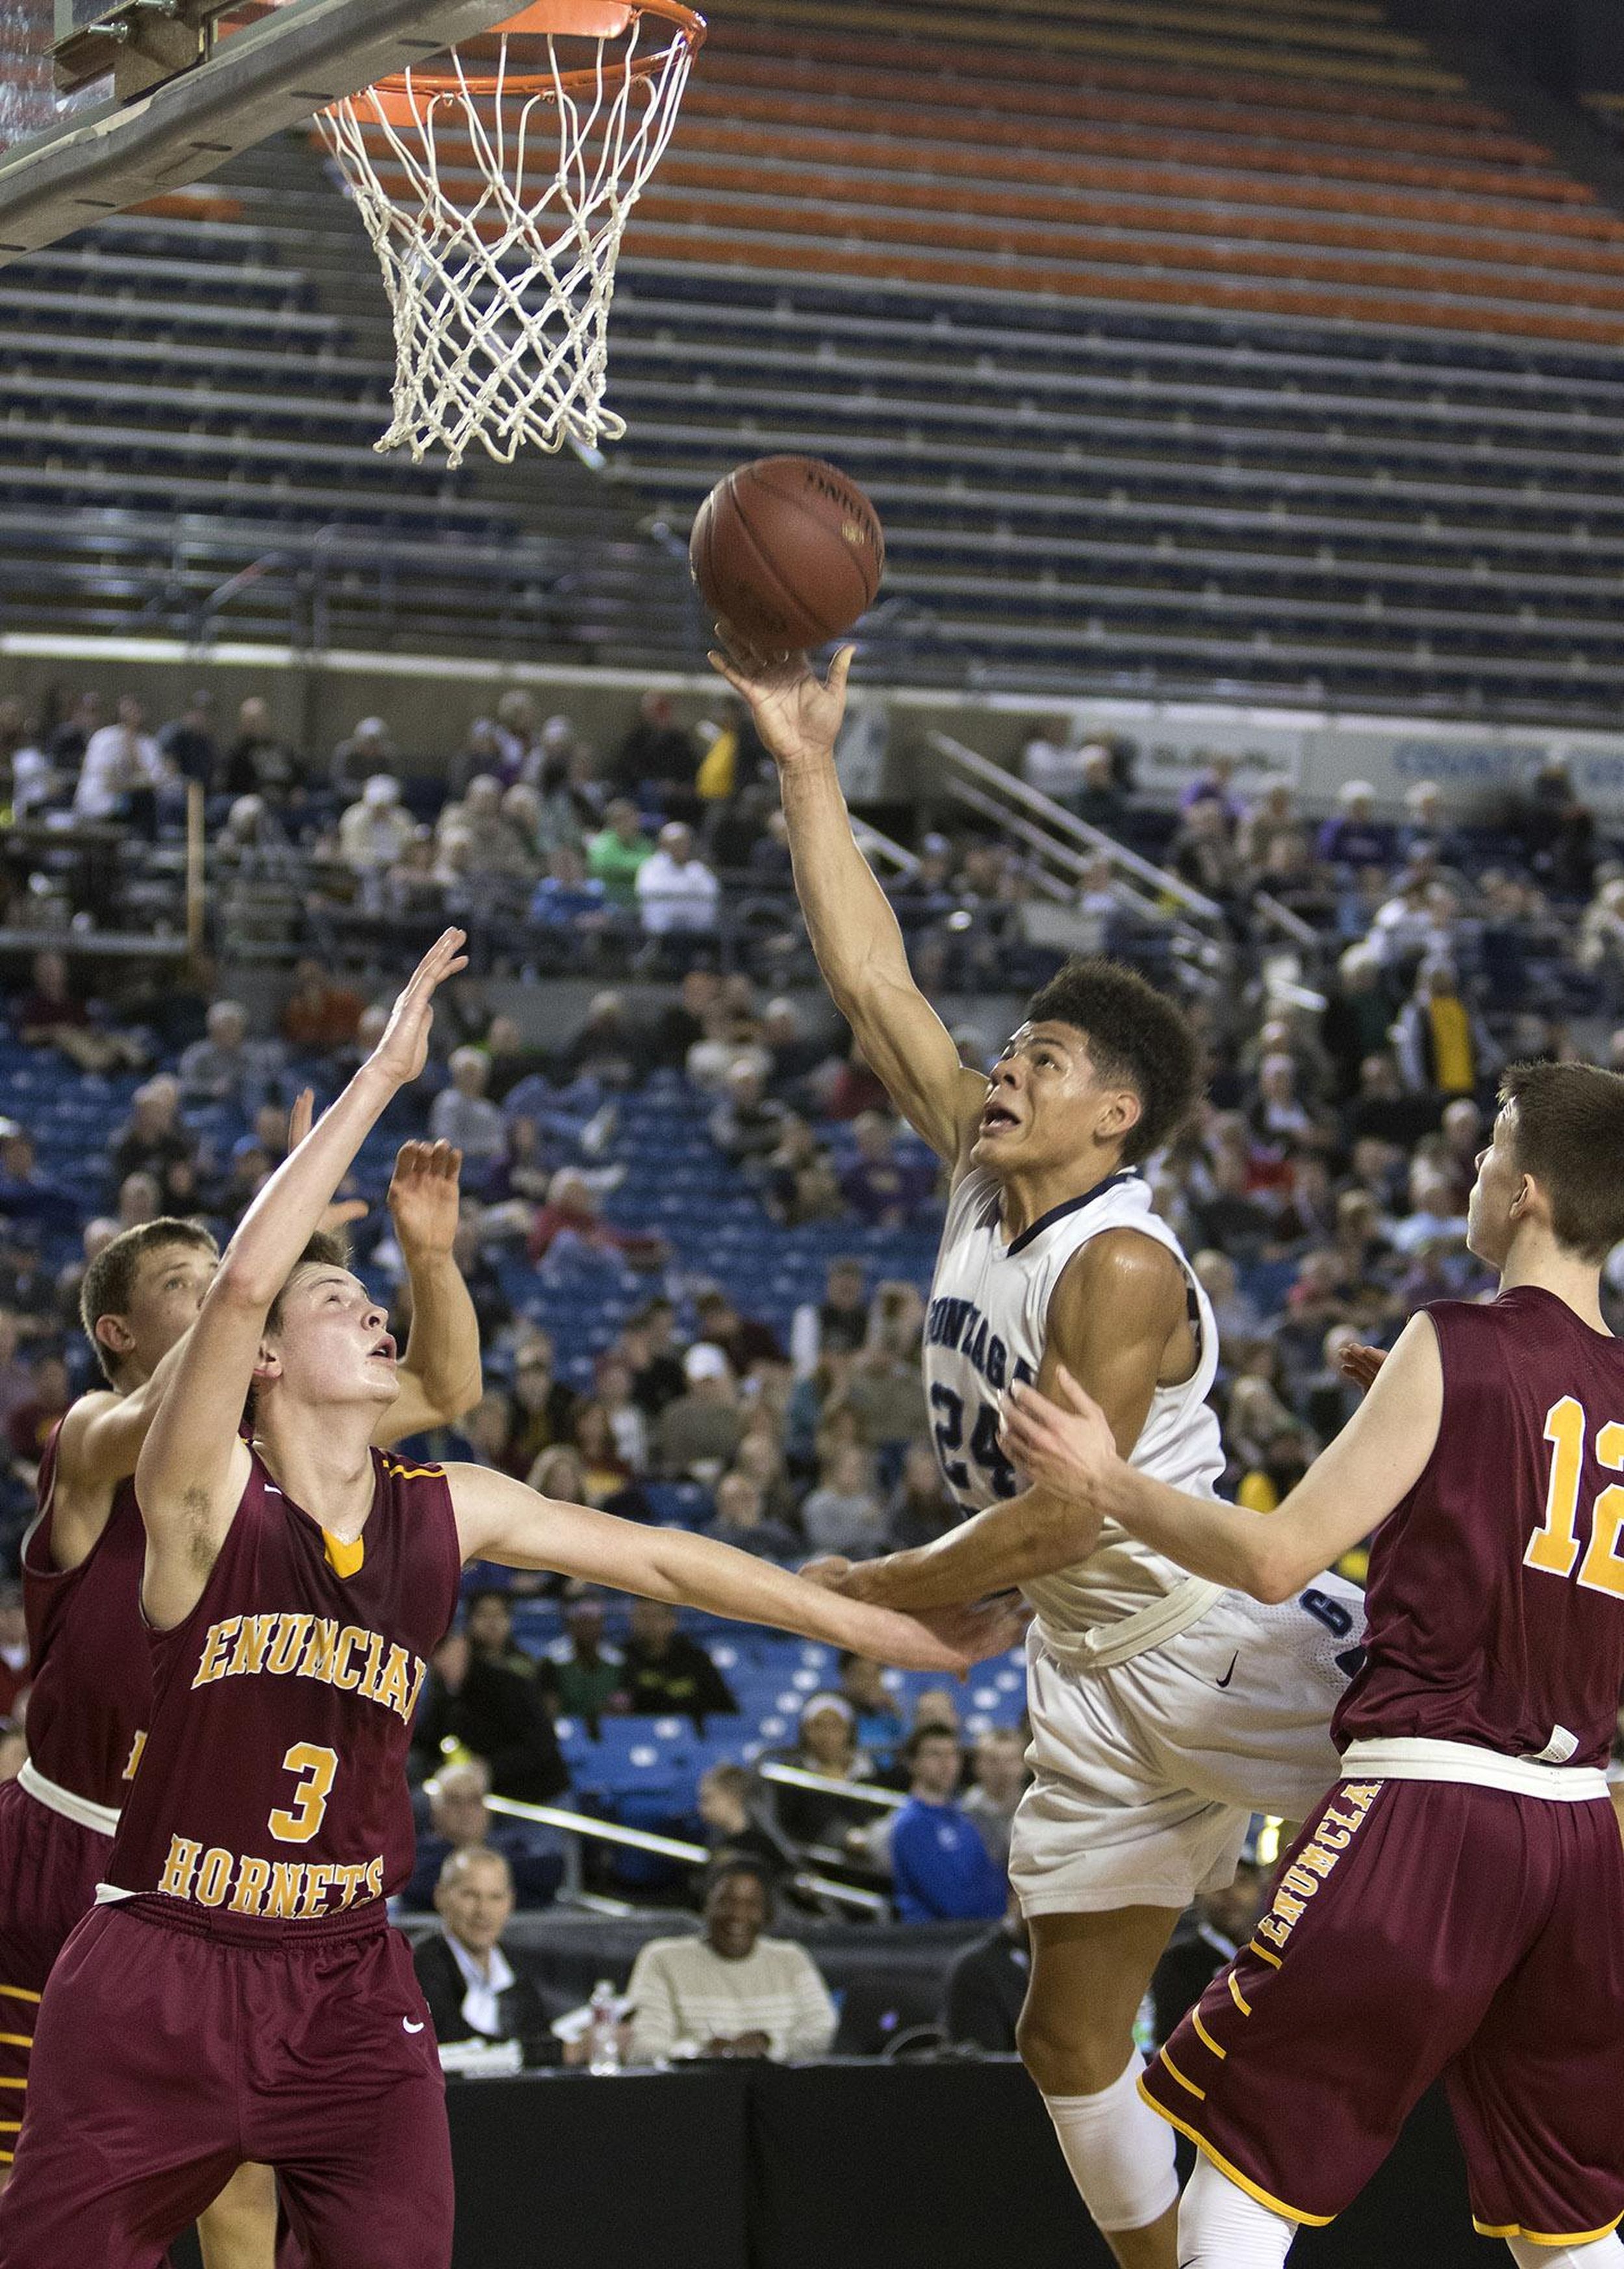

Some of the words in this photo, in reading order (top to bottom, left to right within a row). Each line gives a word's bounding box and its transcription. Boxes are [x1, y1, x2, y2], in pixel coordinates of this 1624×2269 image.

[931, 1381, 1016, 1498] 24
[1523, 1395, 1624, 1600] 12
[268, 1741, 338, 1843] 3
[157, 1834, 383, 1919] HORNETS
[1258, 1780, 1384, 1948] ENUMCLA
